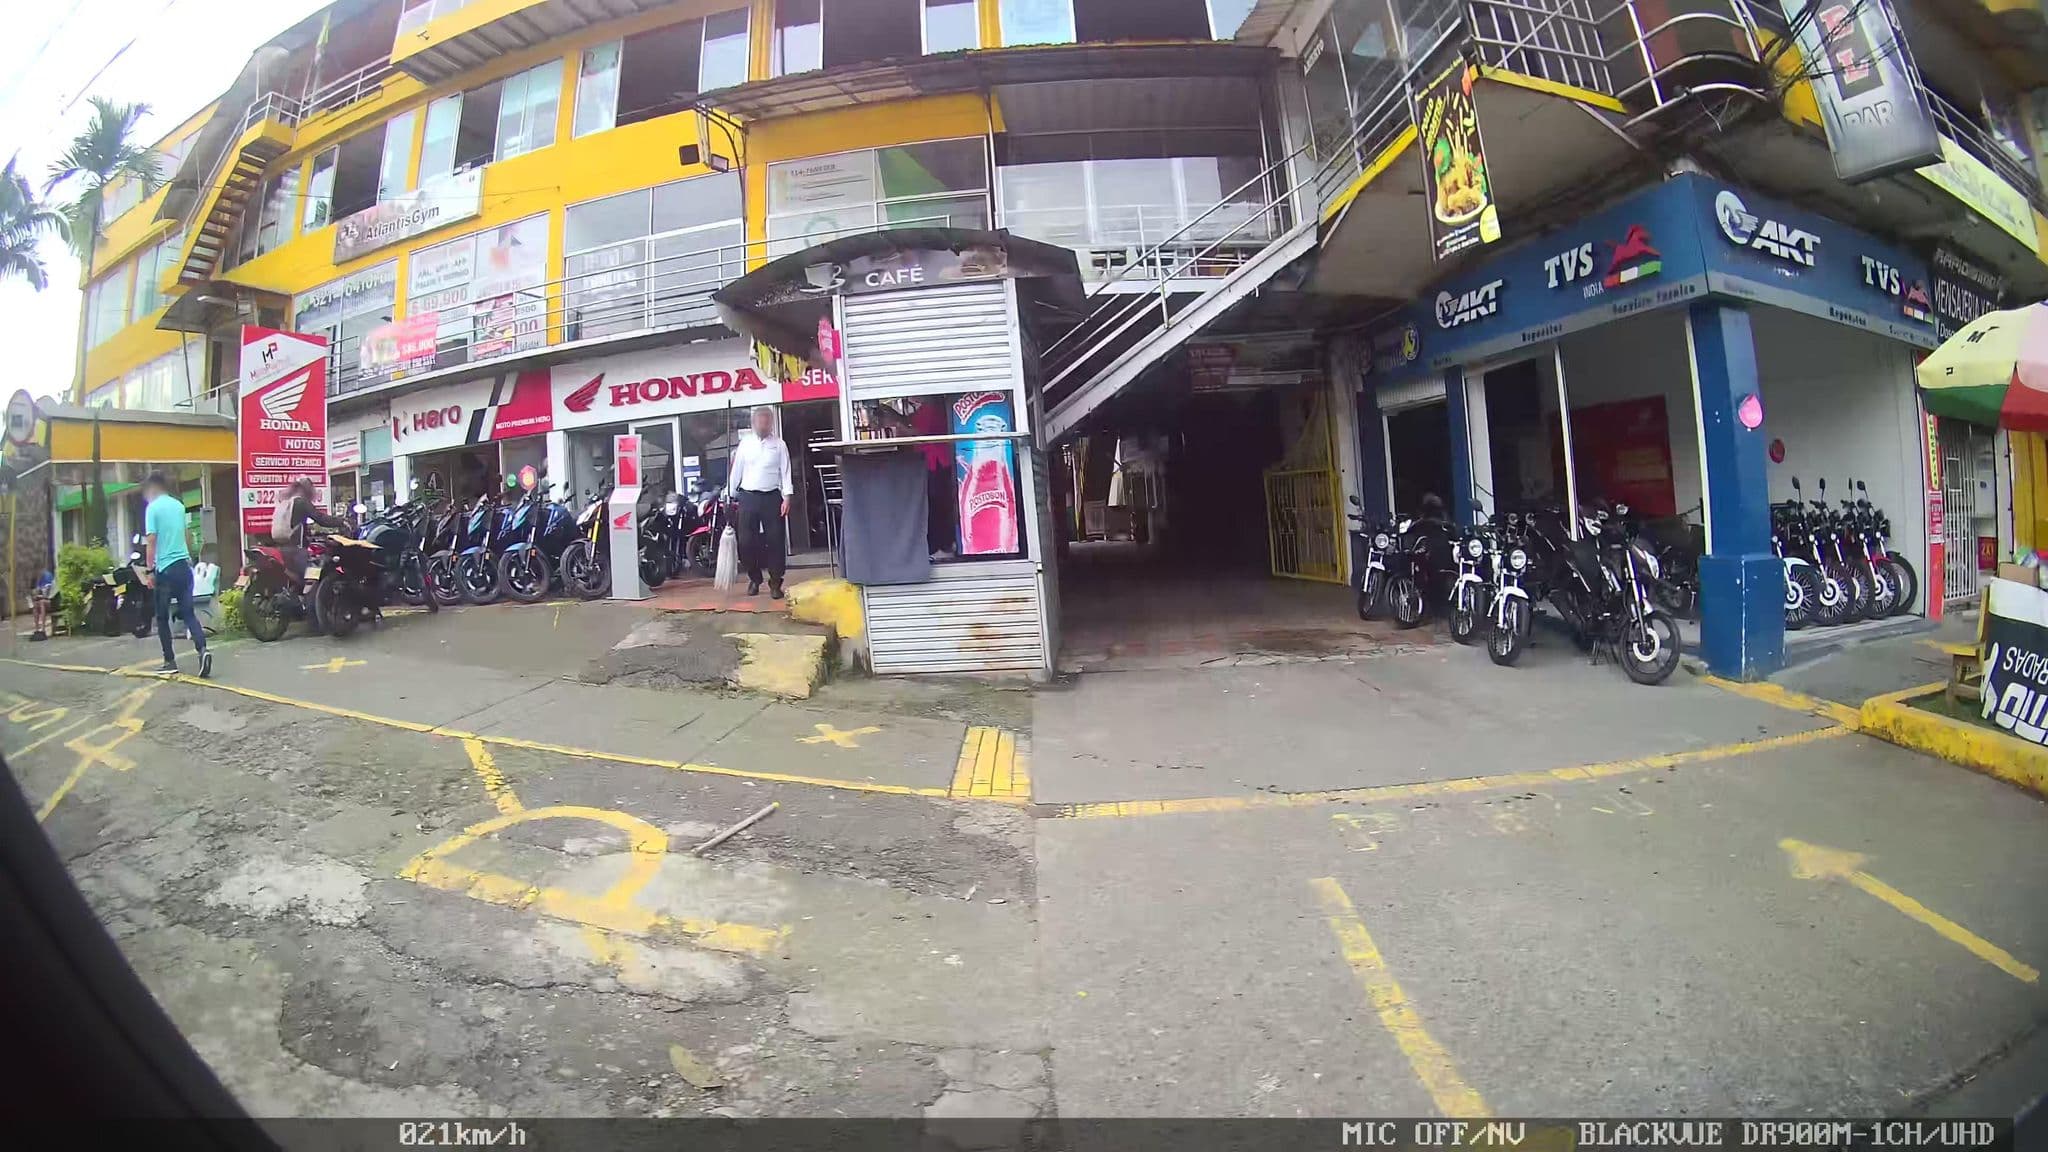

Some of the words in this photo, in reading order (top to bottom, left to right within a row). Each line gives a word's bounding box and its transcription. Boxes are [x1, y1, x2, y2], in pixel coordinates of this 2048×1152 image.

[1844, 100, 1894, 129] BAR
[1751, 219, 1822, 267] AKT
[865, 264, 924, 287] CAFÉ
[1545, 242, 1594, 289] TVS
[1861, 254, 1901, 295] TVS
[1452, 279, 1503, 327] AKT
[1583, 281, 1605, 299] INDIA
[608, 367, 767, 407] HONDA
[259, 419, 313, 432] HONDA
[413, 405, 462, 432] Hero
[496, 421, 511, 430] MOTO
[535, 415, 551, 424] HERO
[285, 439, 321, 450] MOTOS
[255, 457, 289, 467] SERVICIO
